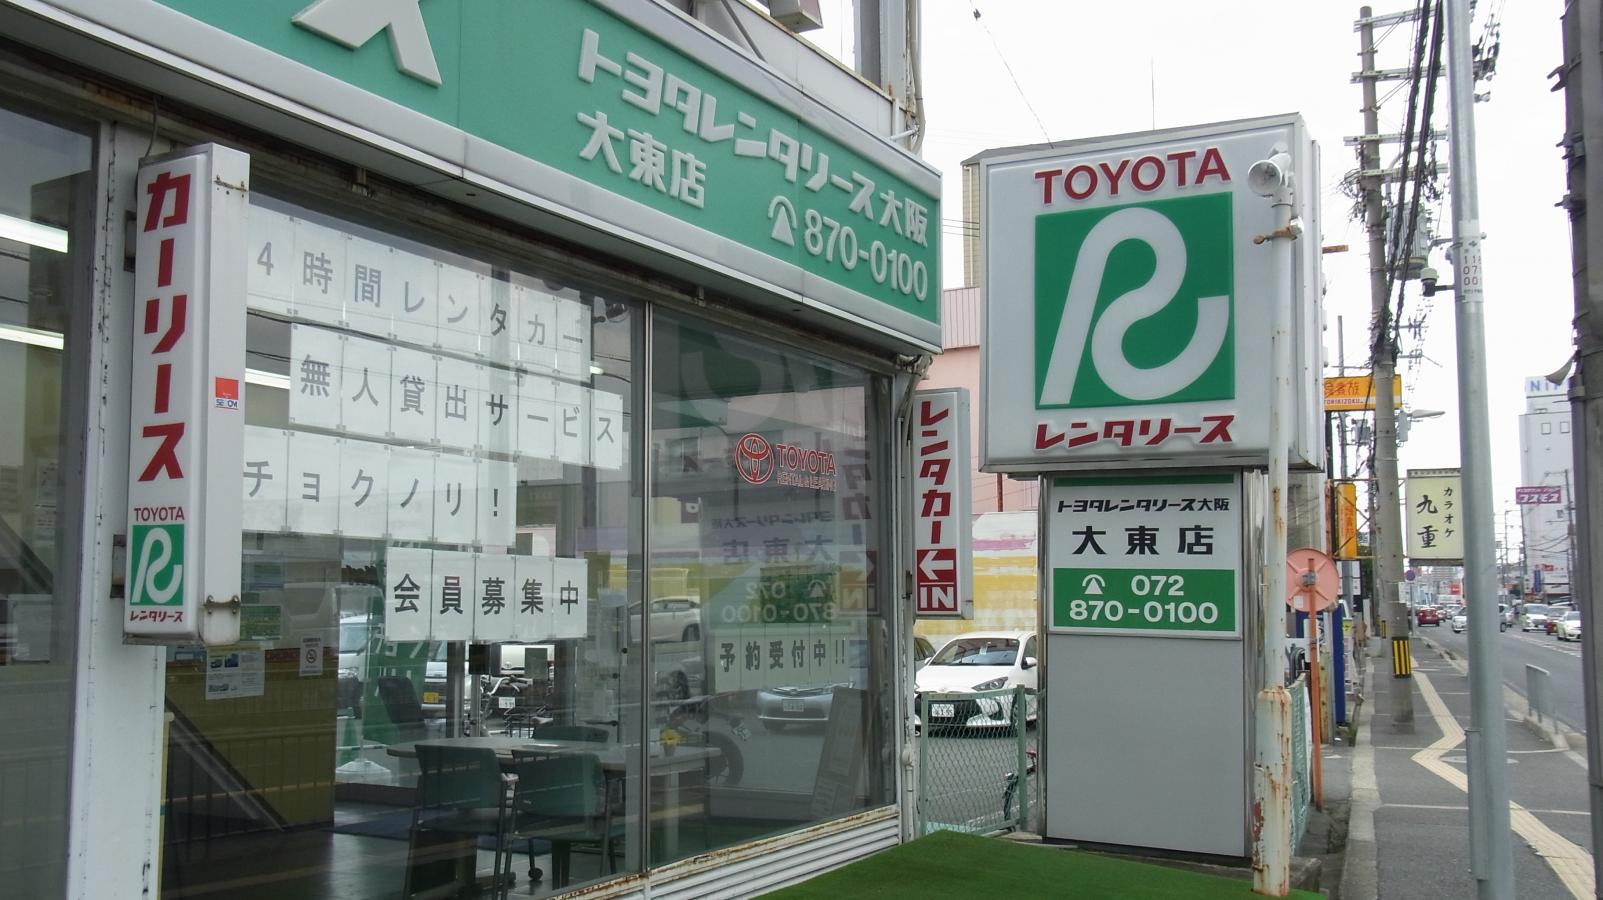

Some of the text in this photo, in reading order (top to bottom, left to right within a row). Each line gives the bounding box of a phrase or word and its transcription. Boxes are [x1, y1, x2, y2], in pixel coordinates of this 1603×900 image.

[577, 111, 706, 208] 大東店
[578, 28, 928, 248] トヨタレンタリース大阪
[1035, 147, 1231, 205] TOYOTA
[804, 208, 928, 301] 870-0100
[257, 241, 583, 346] 4時間レンタカー
[138, 171, 192, 482] カーリース
[215, 399, 238, 408] SEOM
[300, 354, 614, 444] 無人貸出サービス
[1035, 415, 1235, 449] レンタリース
[777, 444, 837, 476] TOYOTA
[920, 401, 952, 544] レンタカー
[133, 506, 185, 521] TOYOTA
[1057, 498, 1230, 513] トヨタレンタリース大阪
[1416, 495, 1439, 548] 九重
[1443, 487, 1454, 538] カラオケ
[1072, 525, 1214, 555] 大東店
[394, 573, 579, 616] 会員募集中
[920, 585, 954, 609] IN
[1131, 575, 1185, 596] 072
[130, 611, 183, 622] レンタリース
[1069, 600, 1218, 624] 870-0100
